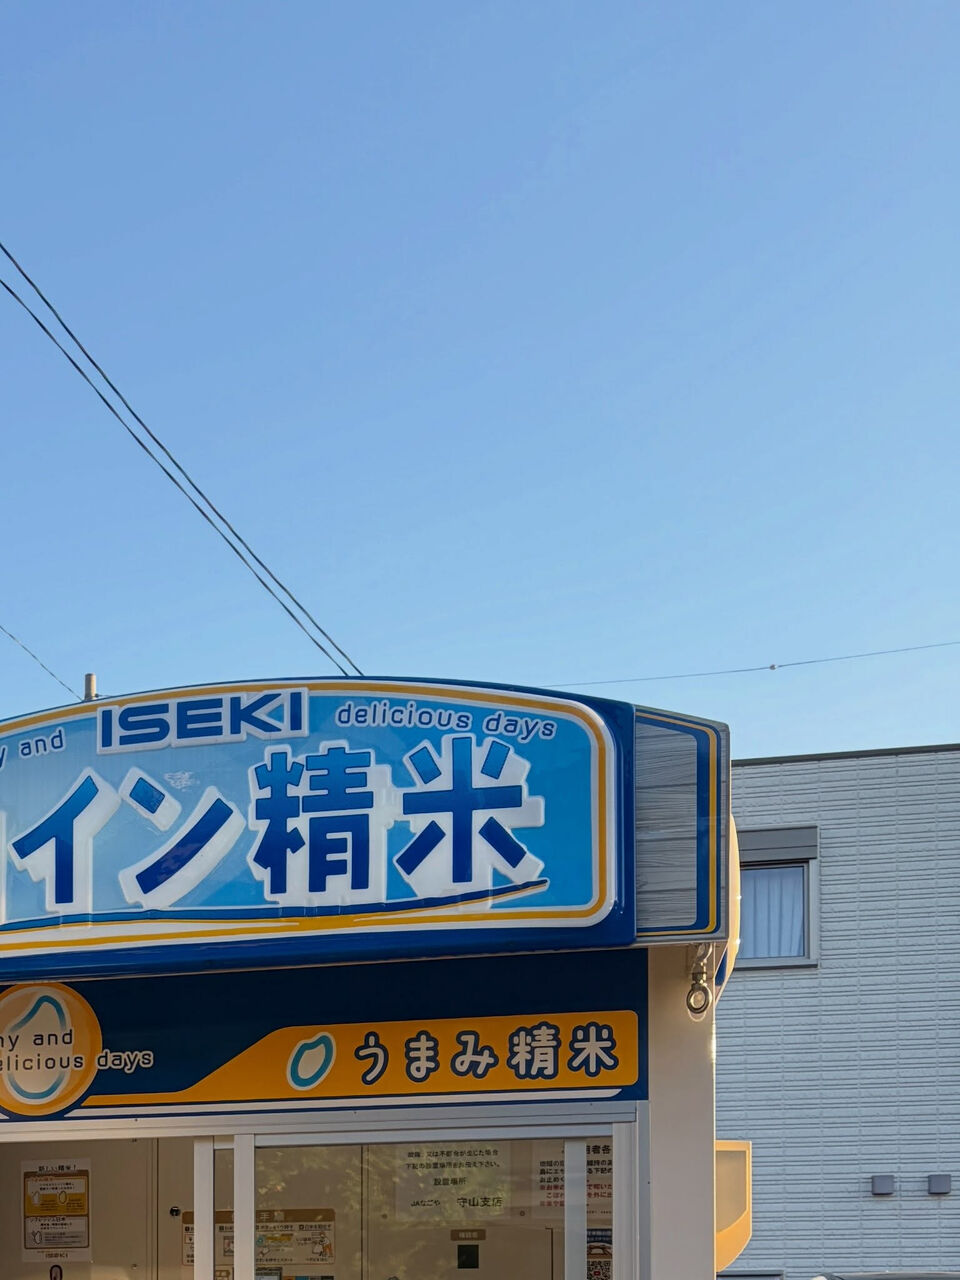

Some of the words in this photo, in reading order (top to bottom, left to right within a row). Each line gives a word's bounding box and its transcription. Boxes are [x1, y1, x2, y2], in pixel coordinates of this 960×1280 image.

[101, 691, 303, 749] ISEKI
[338, 701, 471, 728] delicious
[484, 712, 554, 739] days
[20, 729, 64, 757] and
[33, 1029, 73, 1045] and
[96, 1050, 153, 1073] days
[357, 1024, 616, 1083] うまみ精米
[457, 1197, 502, 1208] 守山支店
